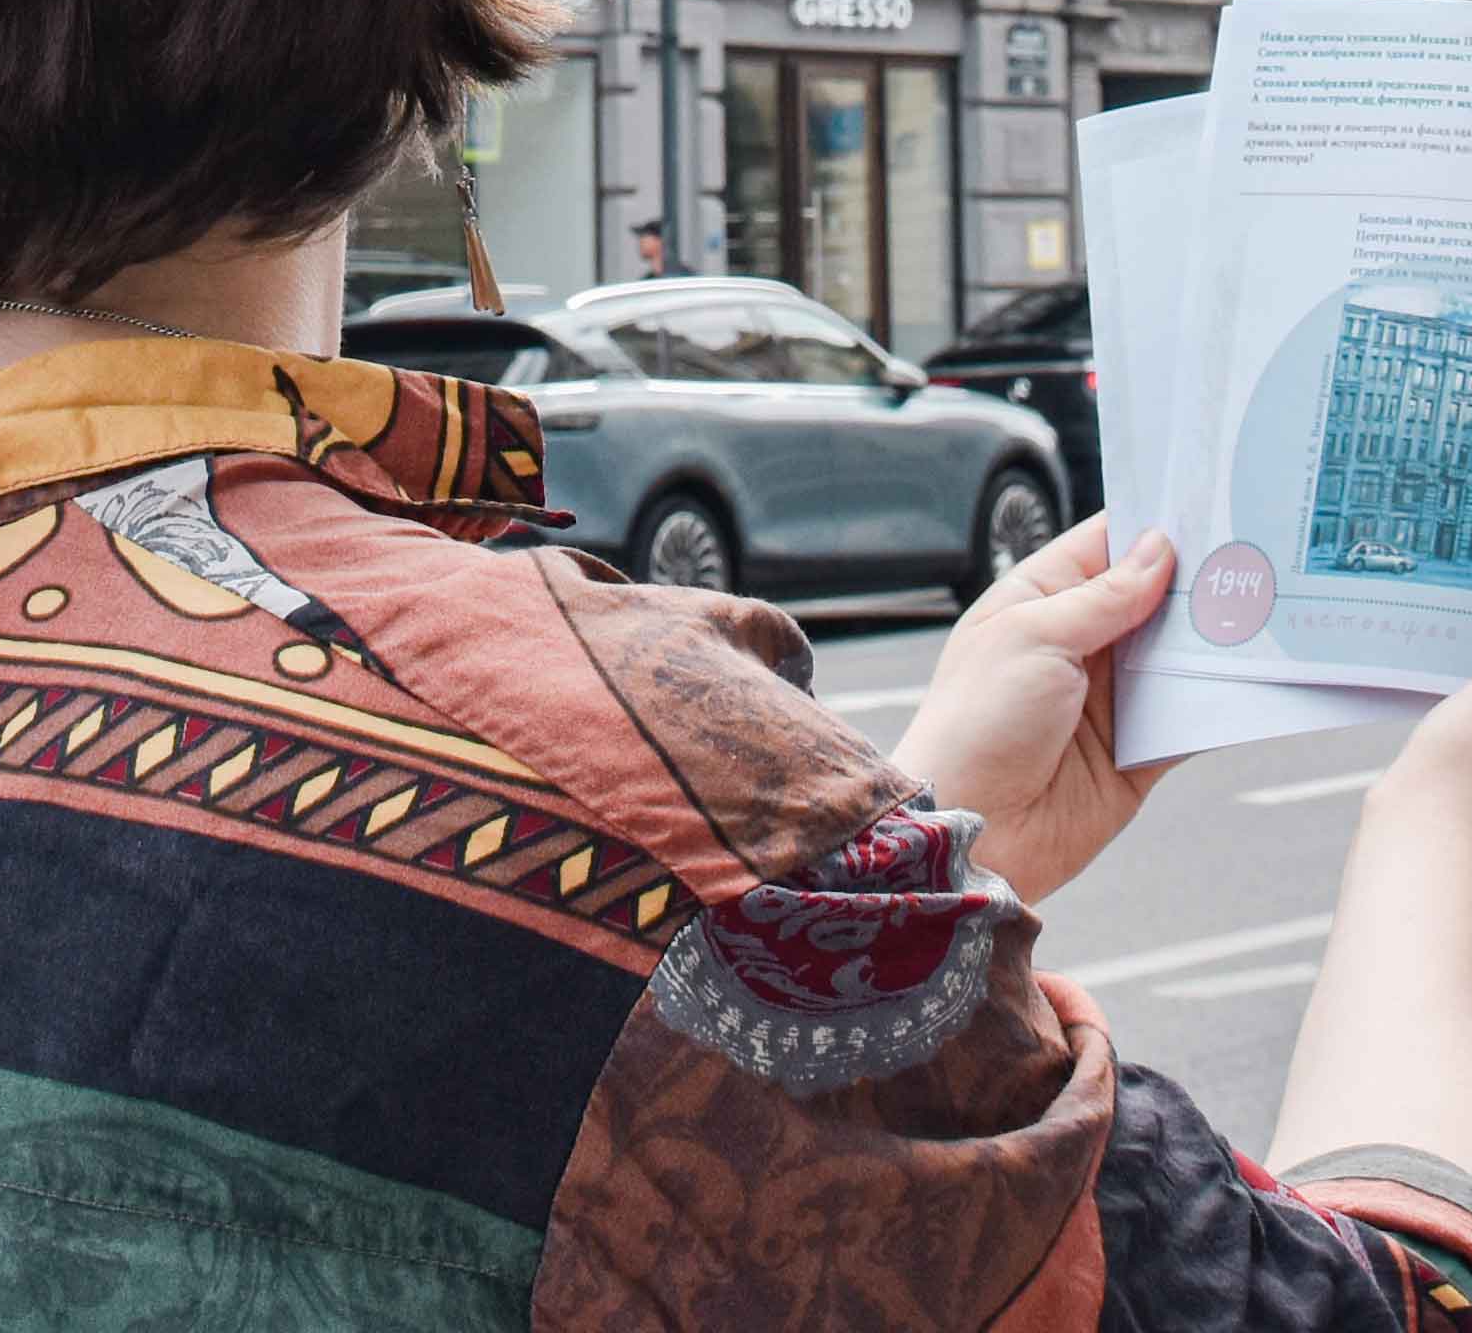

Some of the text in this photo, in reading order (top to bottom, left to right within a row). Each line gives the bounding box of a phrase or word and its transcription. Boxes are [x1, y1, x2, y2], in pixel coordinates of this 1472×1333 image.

[1410, 32, 1460, 46] Михаила
[1386, 49, 1425, 62] зданий
[1428, 51, 1441, 60] на
[1253, 77, 1299, 89] Сколько
[1302, 77, 1373, 91] изображений
[1456, 84, 1470, 94] на
[1251, 93, 1259, 103] А
[1265, 93, 1308, 104] сколько
[1310, 95, 1360, 107] построек
[1285, 123, 1298, 133] на
[1343, 124, 1397, 136] посмотри
[1330, 139, 1407, 153] исторический
[1358, 212, 1413, 226] Большой
[1355, 229, 1436, 247] Центральная
[1353, 247, 1452, 265] Петроградского
[1207, 566, 1264, 597] 1944
